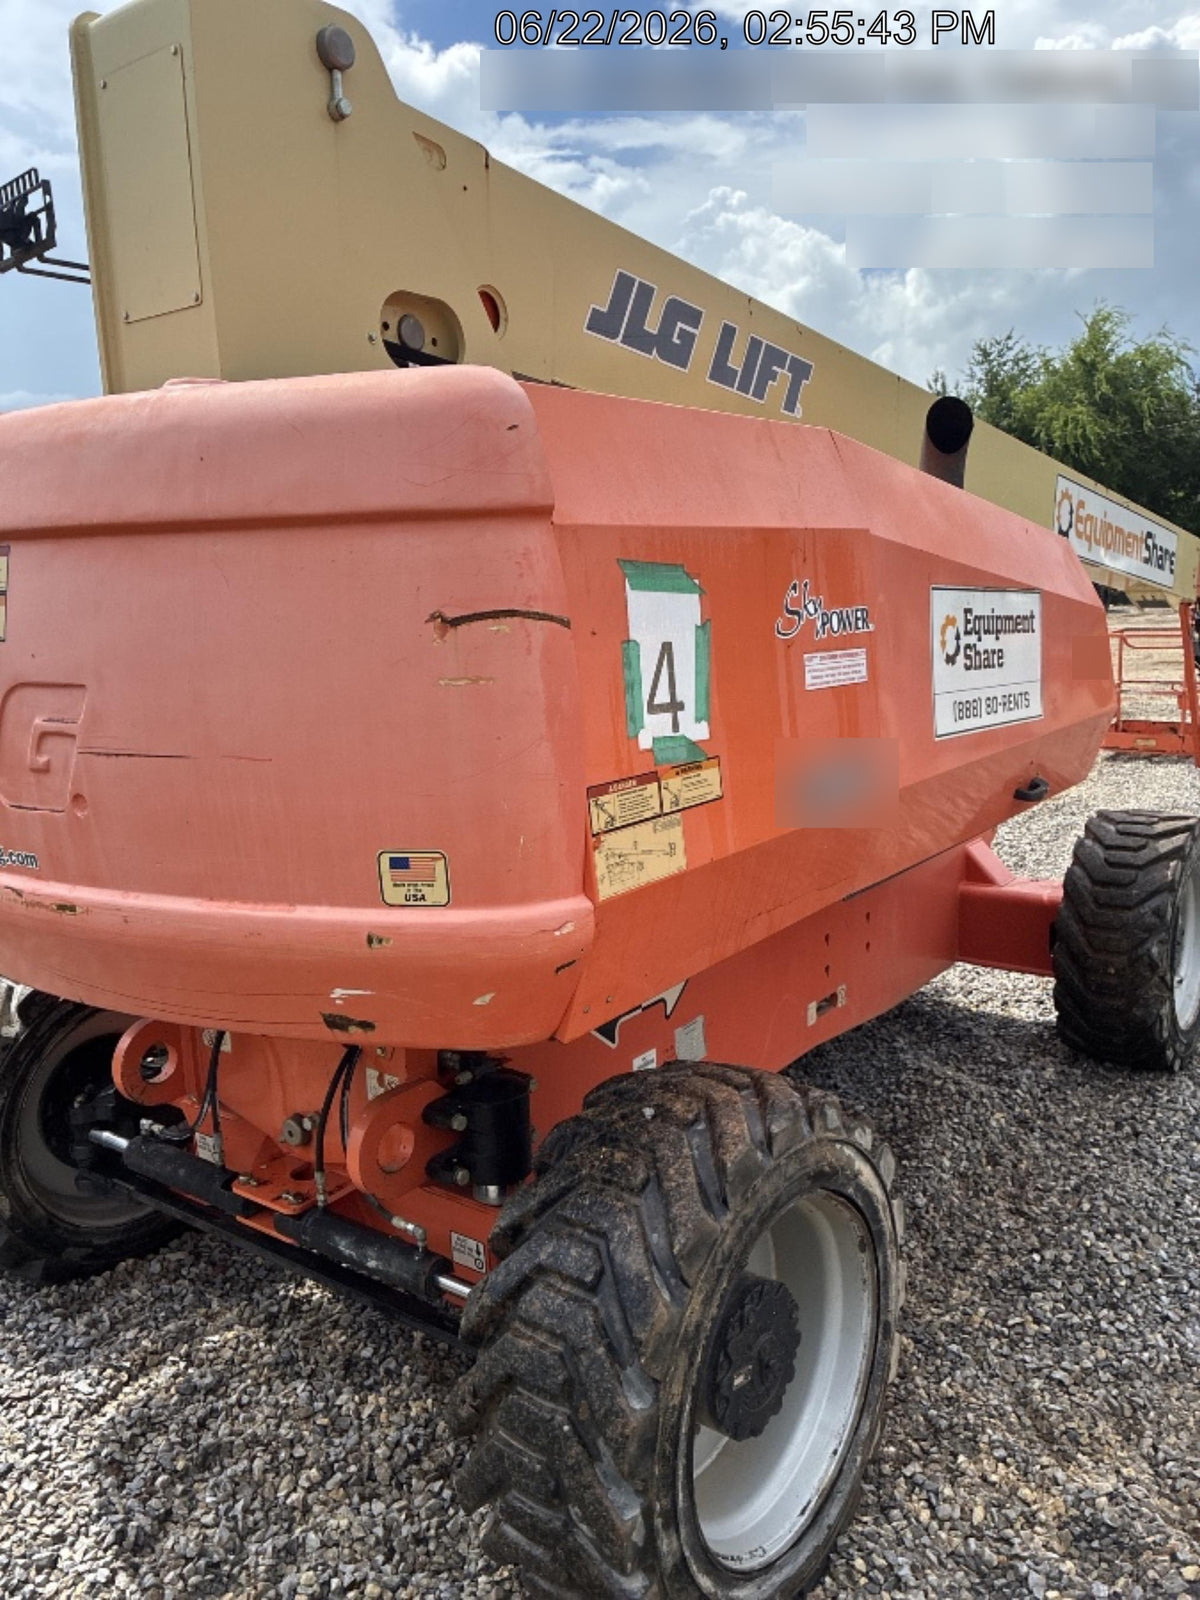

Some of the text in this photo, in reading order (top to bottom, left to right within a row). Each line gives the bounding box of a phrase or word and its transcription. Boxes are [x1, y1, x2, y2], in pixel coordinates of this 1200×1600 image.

[584, 268, 815, 417] JLG LIFT
[1074, 499, 1176, 575] EquipmentShare
[775, 579, 871, 640] Sky POWER
[963, 607, 1036, 642] Equipment
[963, 643, 1004, 671] Share
[647, 641, 685, 733] 4
[953, 697, 983, 722] (888)
[404, 893, 427, 902] USA
